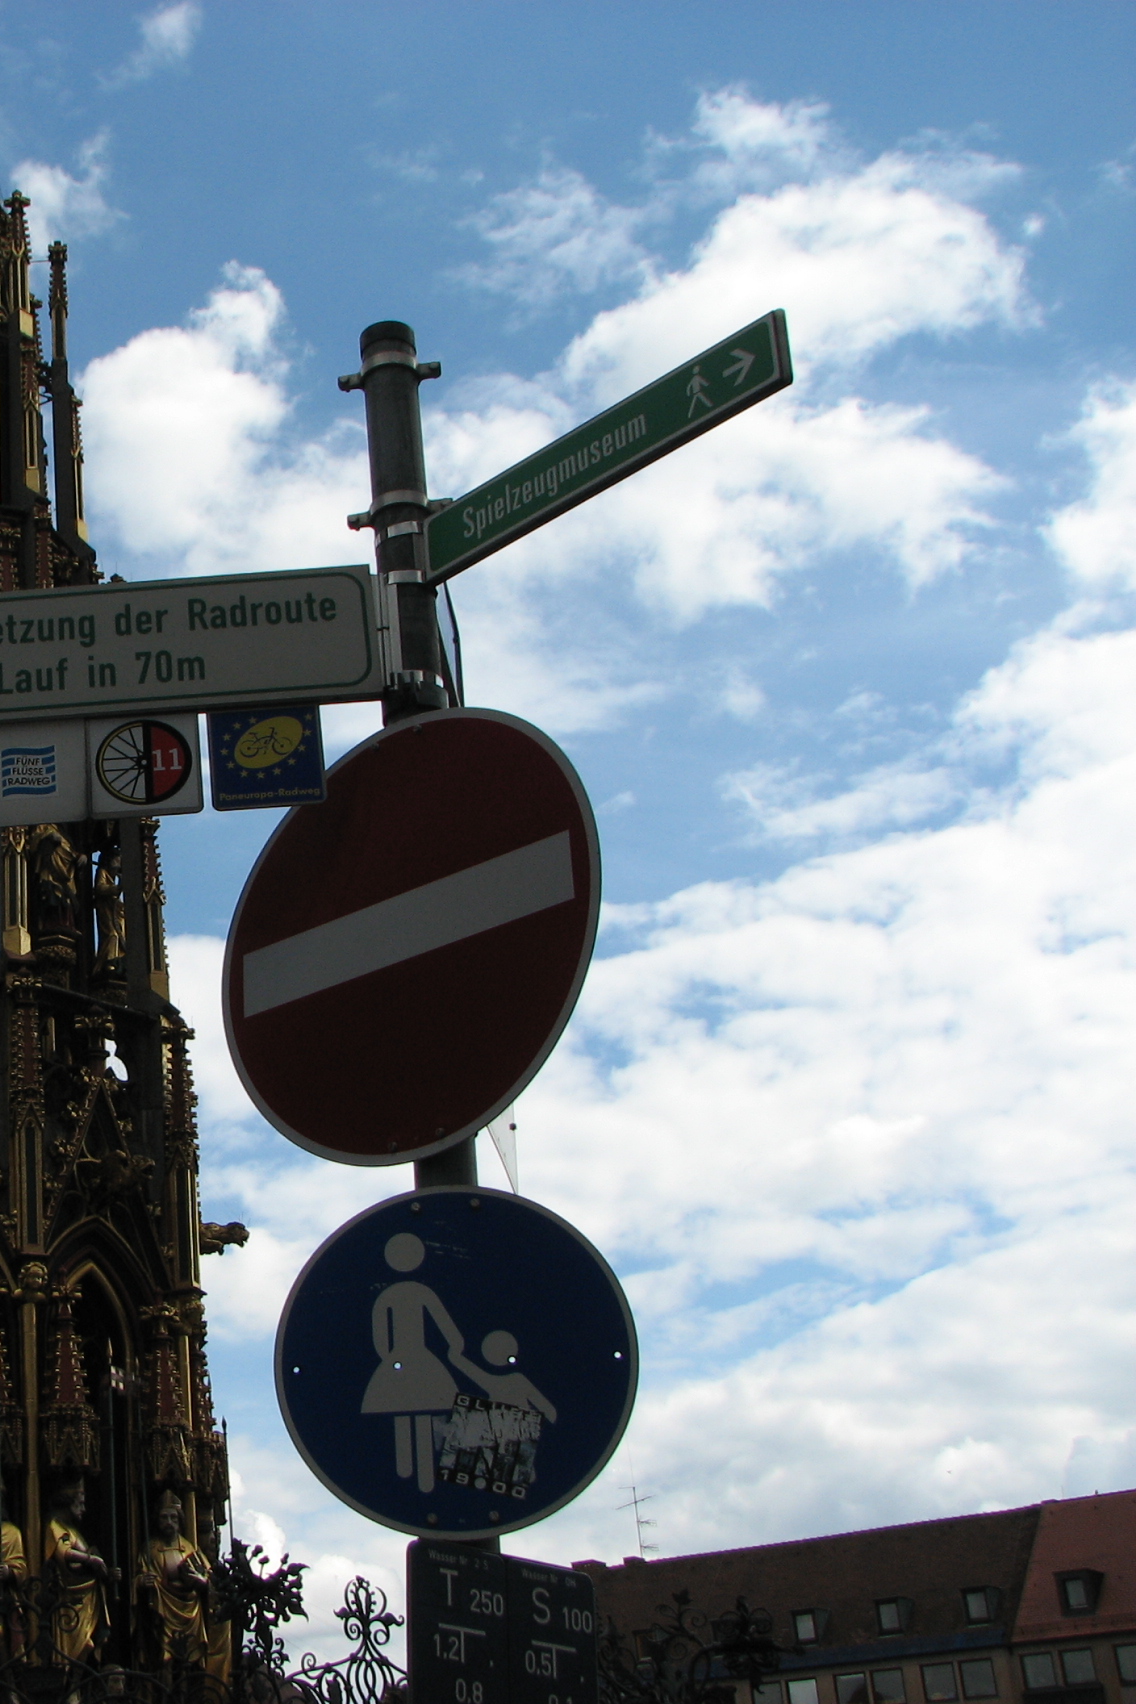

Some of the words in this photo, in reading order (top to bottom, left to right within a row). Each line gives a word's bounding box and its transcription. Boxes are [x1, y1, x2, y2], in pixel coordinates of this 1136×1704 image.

[463, 413, 647, 540] Spielzeugmuseum
[114, 602, 167, 636] der
[188, 590, 337, 631] Radroute
[87, 655, 117, 688] in
[135, 651, 206, 683] 70m
[12, 766, 44, 776] FLÜSSE
[16, 756, 41, 766] FÜNF
[153, 748, 182, 771] 11
[7, 776, 51, 786] RADWEG
[219, 787, 321, 801] Paneuropa-Radweg
[440, 1568, 458, 1606] T
[469, 1588, 504, 1617] 250
[531, 1587, 551, 1625] S
[562, 1606, 593, 1634] 100
